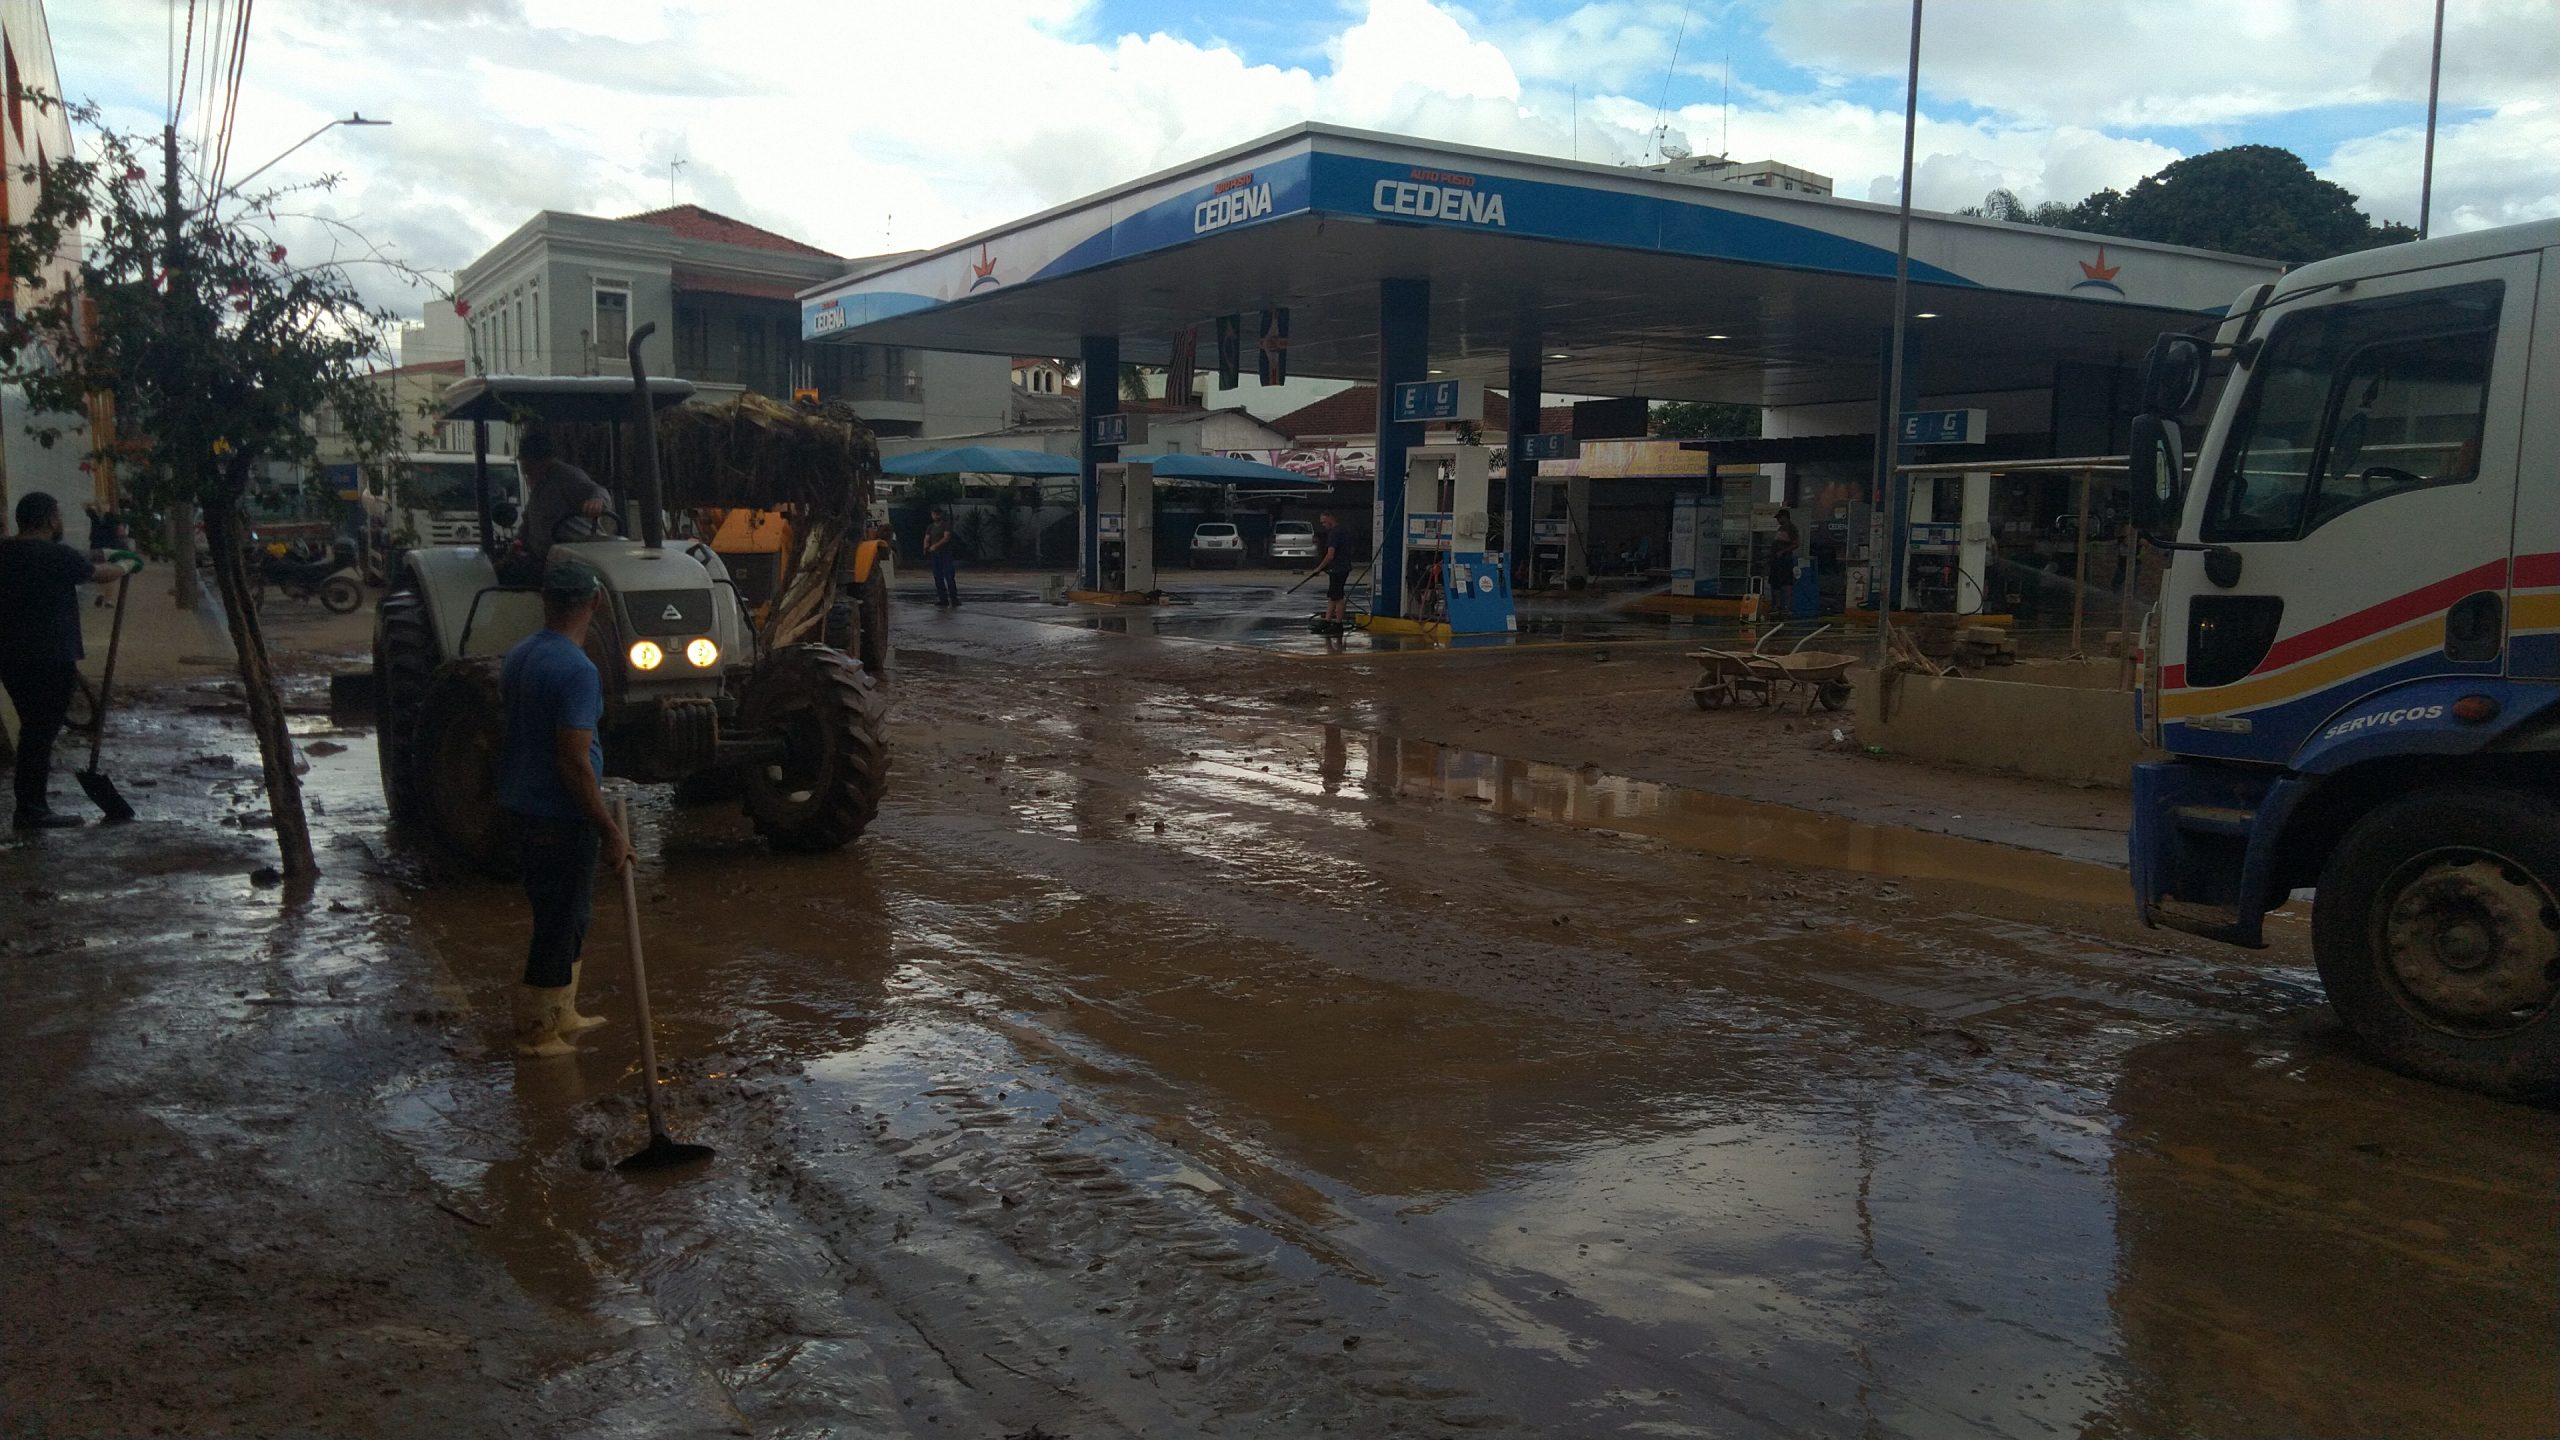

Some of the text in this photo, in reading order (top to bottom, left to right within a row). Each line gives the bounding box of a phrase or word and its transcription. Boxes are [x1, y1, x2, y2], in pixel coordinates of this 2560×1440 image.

[1410, 170, 1438, 181] AUTO
[1194, 182, 1272, 234] CEDENA
[1373, 179, 1506, 226] CEDENA
[814, 307, 845, 332] CEDENA
[1405, 383, 1449, 409] E G
[1906, 413, 1957, 434] E G
[2324, 705, 2443, 740] SERVIÇOS
